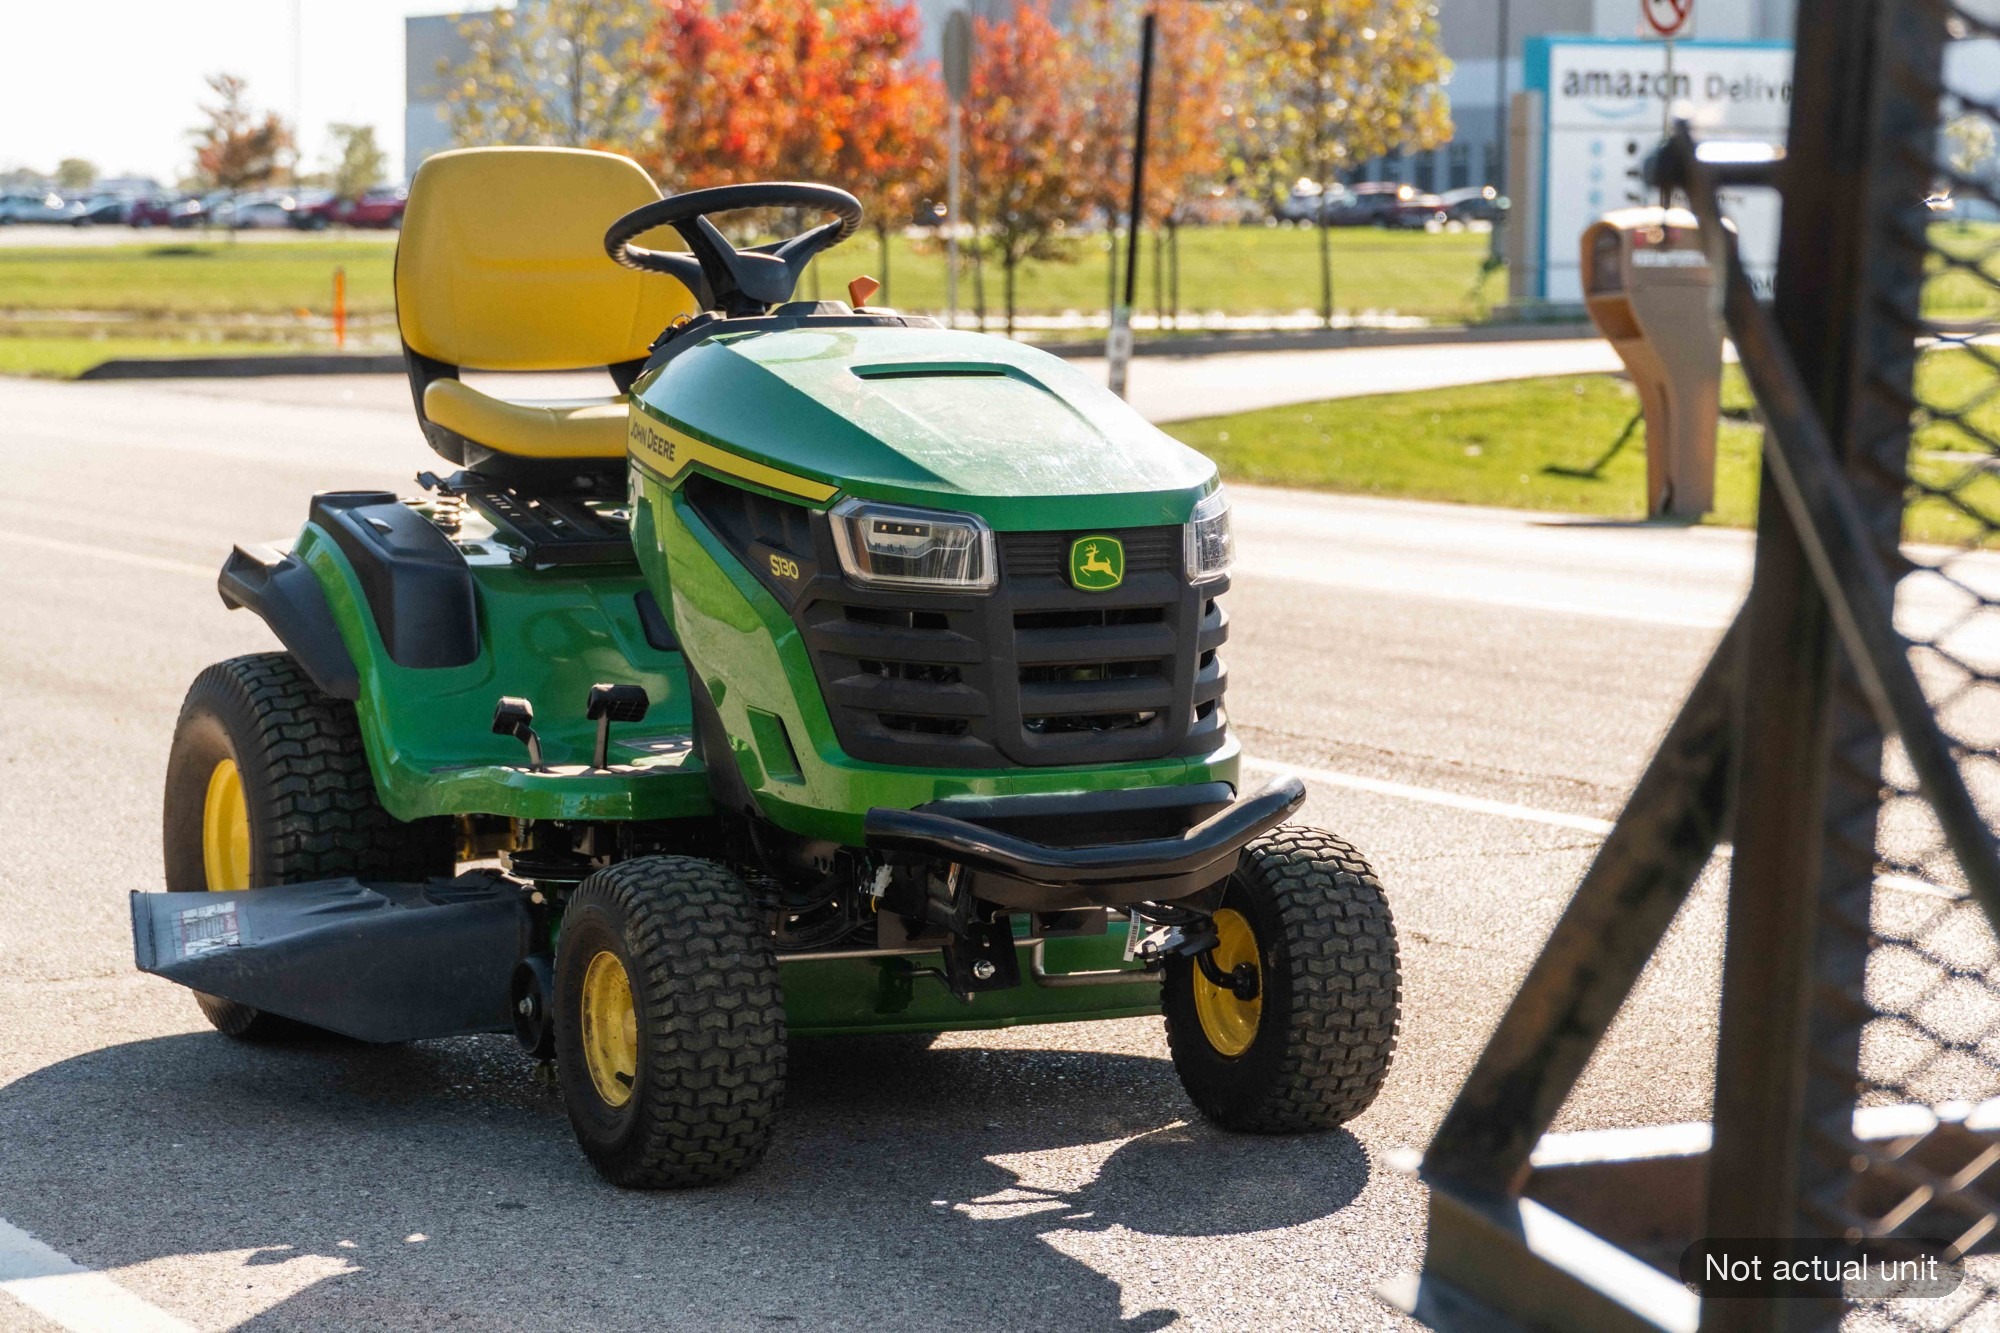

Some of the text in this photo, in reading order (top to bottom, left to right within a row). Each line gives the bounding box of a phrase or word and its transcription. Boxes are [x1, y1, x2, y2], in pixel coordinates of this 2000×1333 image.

[1562, 69, 1690, 98] amazon
[630, 416, 675, 461] JOHN DEERE
[769, 554, 799, 580] S130
